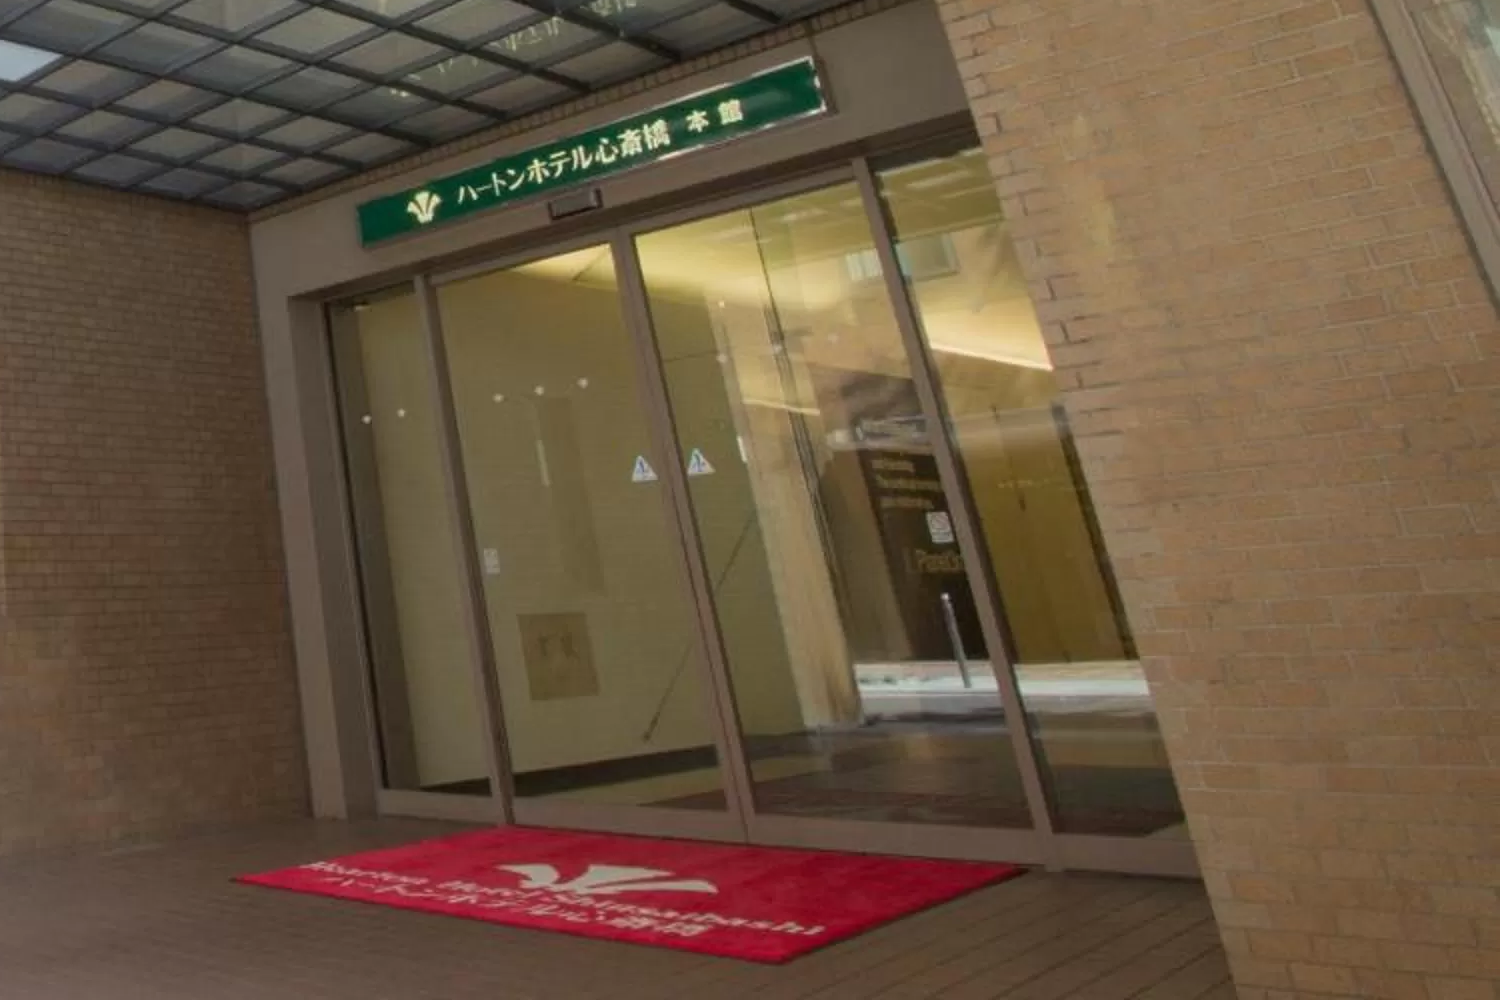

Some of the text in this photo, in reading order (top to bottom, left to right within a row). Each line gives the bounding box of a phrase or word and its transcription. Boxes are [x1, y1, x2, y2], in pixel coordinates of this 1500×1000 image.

[457, 119, 671, 204] ハートンホテル心斎橋
